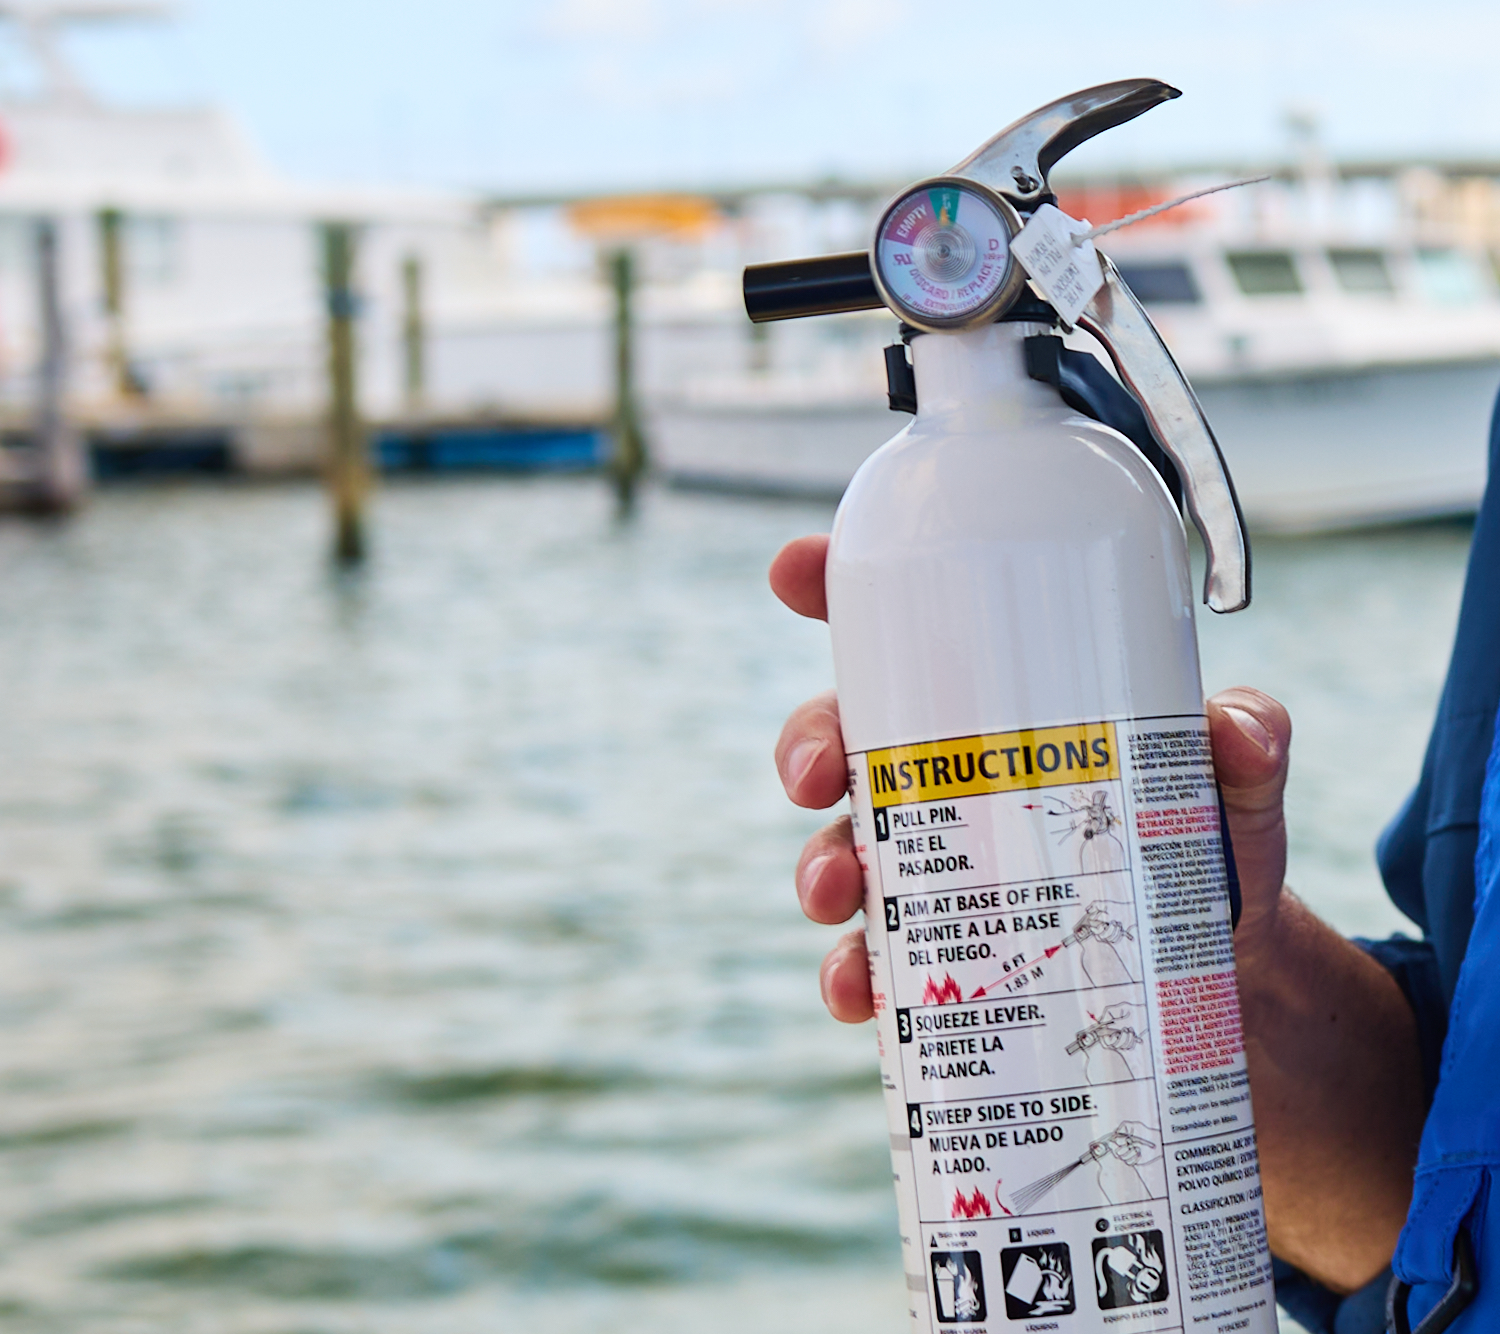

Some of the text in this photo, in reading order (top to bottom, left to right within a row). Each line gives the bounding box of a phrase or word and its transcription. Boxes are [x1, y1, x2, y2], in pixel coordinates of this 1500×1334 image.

[897, 204, 927, 238] EMPTY
[957, 262, 993, 298] REPLACE
[873, 737, 1110, 794] INSTRUCTIONS
[893, 810, 925, 829] PULL
[929, 806, 962, 823] PIN.
[896, 835, 946, 855] TIRE EL
[899, 855, 974, 877] PASADOR.
[903, 900, 929, 917] AIM
[934, 897, 951, 913] AT
[957, 891, 1000, 911] BASE
[1007, 888, 1031, 906] OF
[1036, 883, 1080, 902] FIRE.
[907, 912, 1060, 944] APUNTE A LA BASE
[909, 943, 997, 966] DEL FUEGO.
[1002, 952, 1027, 973] 6 FT
[1004, 966, 1044, 993] 1.83 M
[916, 1011, 980, 1032] SQUEEZE
[985, 1004, 1046, 1025] LEVER.
[919, 1036, 1004, 1058] APRIETE LA
[921, 1060, 996, 1080] PALANCA.
[926, 1108, 972, 1126] SWEEP
[977, 1103, 1016, 1122] SIDE
[1020, 1100, 1044, 1117] TO
[1050, 1095, 1098, 1114] SIDE.
[929, 1126, 1064, 1152] MUEVA DE LADO
[932, 1156, 991, 1175] A LADO.
